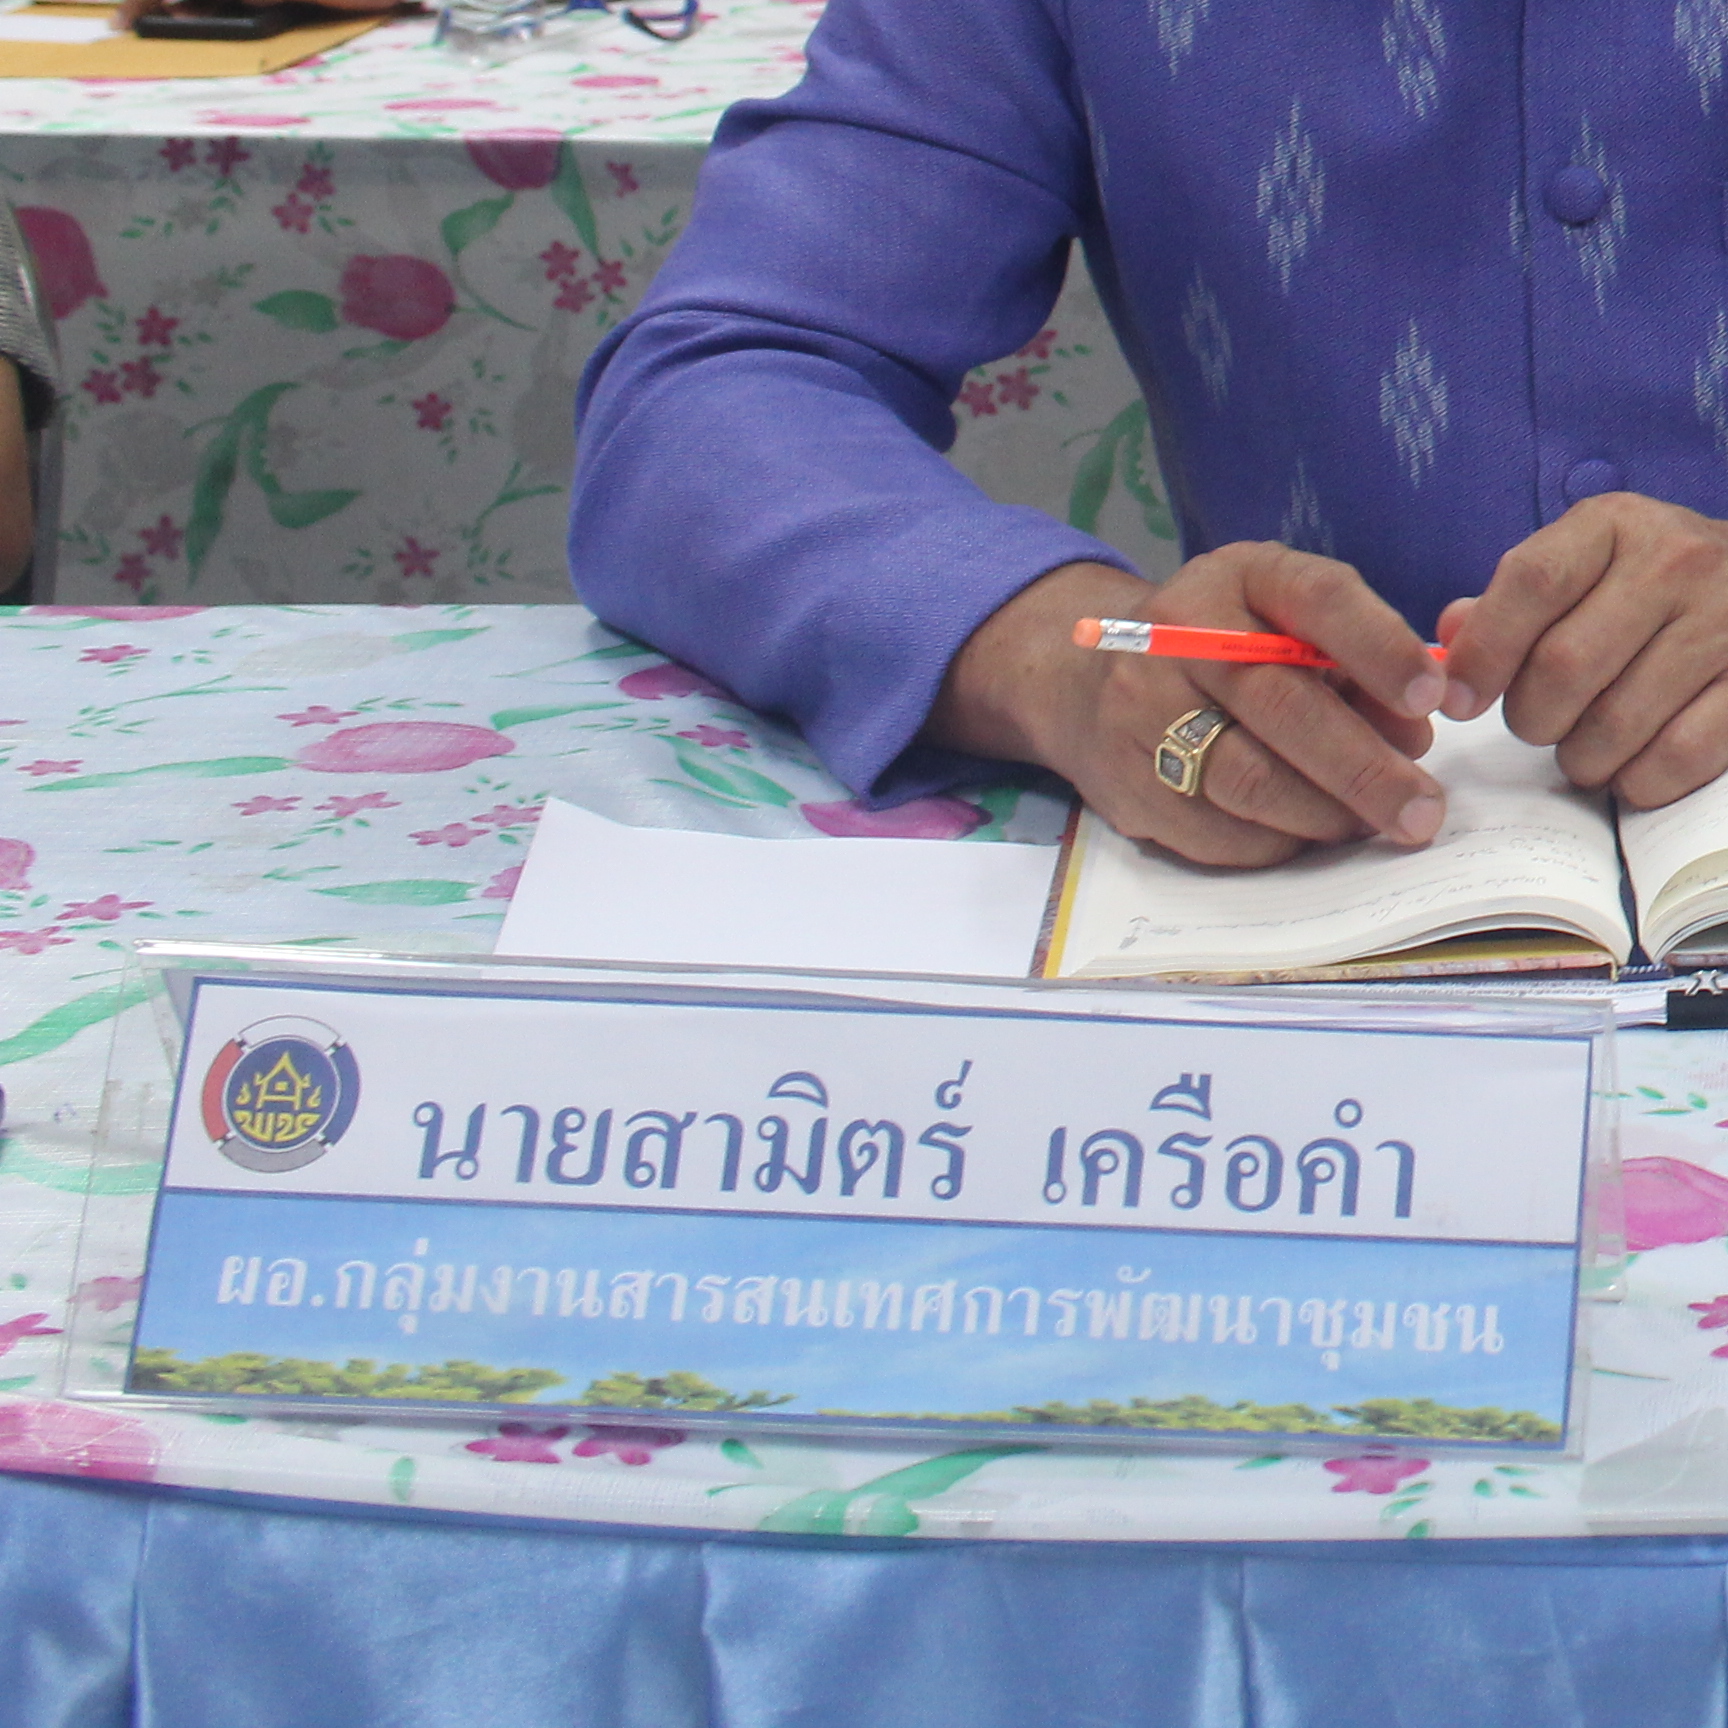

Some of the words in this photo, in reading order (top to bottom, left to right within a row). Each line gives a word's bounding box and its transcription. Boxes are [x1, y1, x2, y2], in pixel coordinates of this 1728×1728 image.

[412, 1059, 974, 1201] นายสามิตร์
[1043, 1073, 1416, 1219] เครือคำ
[216, 1237, 1505, 1371] ผอ.กลุ่มงานสารสนเทศการพัฒนาชุมชน
